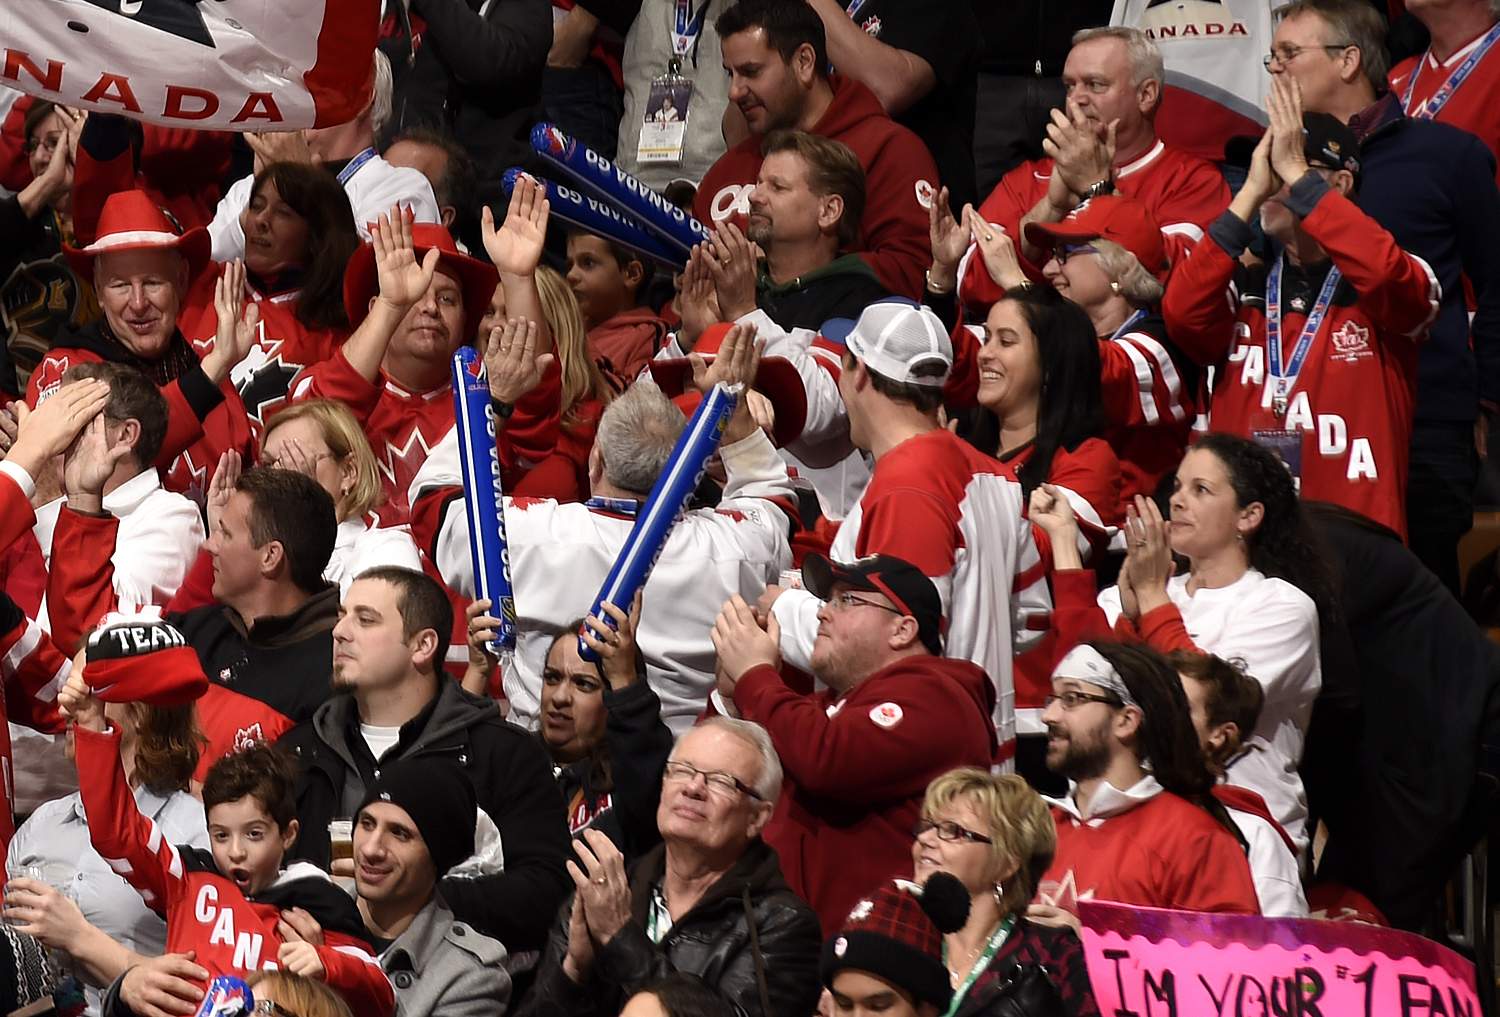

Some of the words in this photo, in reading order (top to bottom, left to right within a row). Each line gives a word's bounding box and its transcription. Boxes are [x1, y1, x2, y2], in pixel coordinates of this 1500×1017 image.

[487, 443, 509, 547] CANADA
[110, 623, 188, 653] TEAM
[194, 884, 279, 971] CAN
